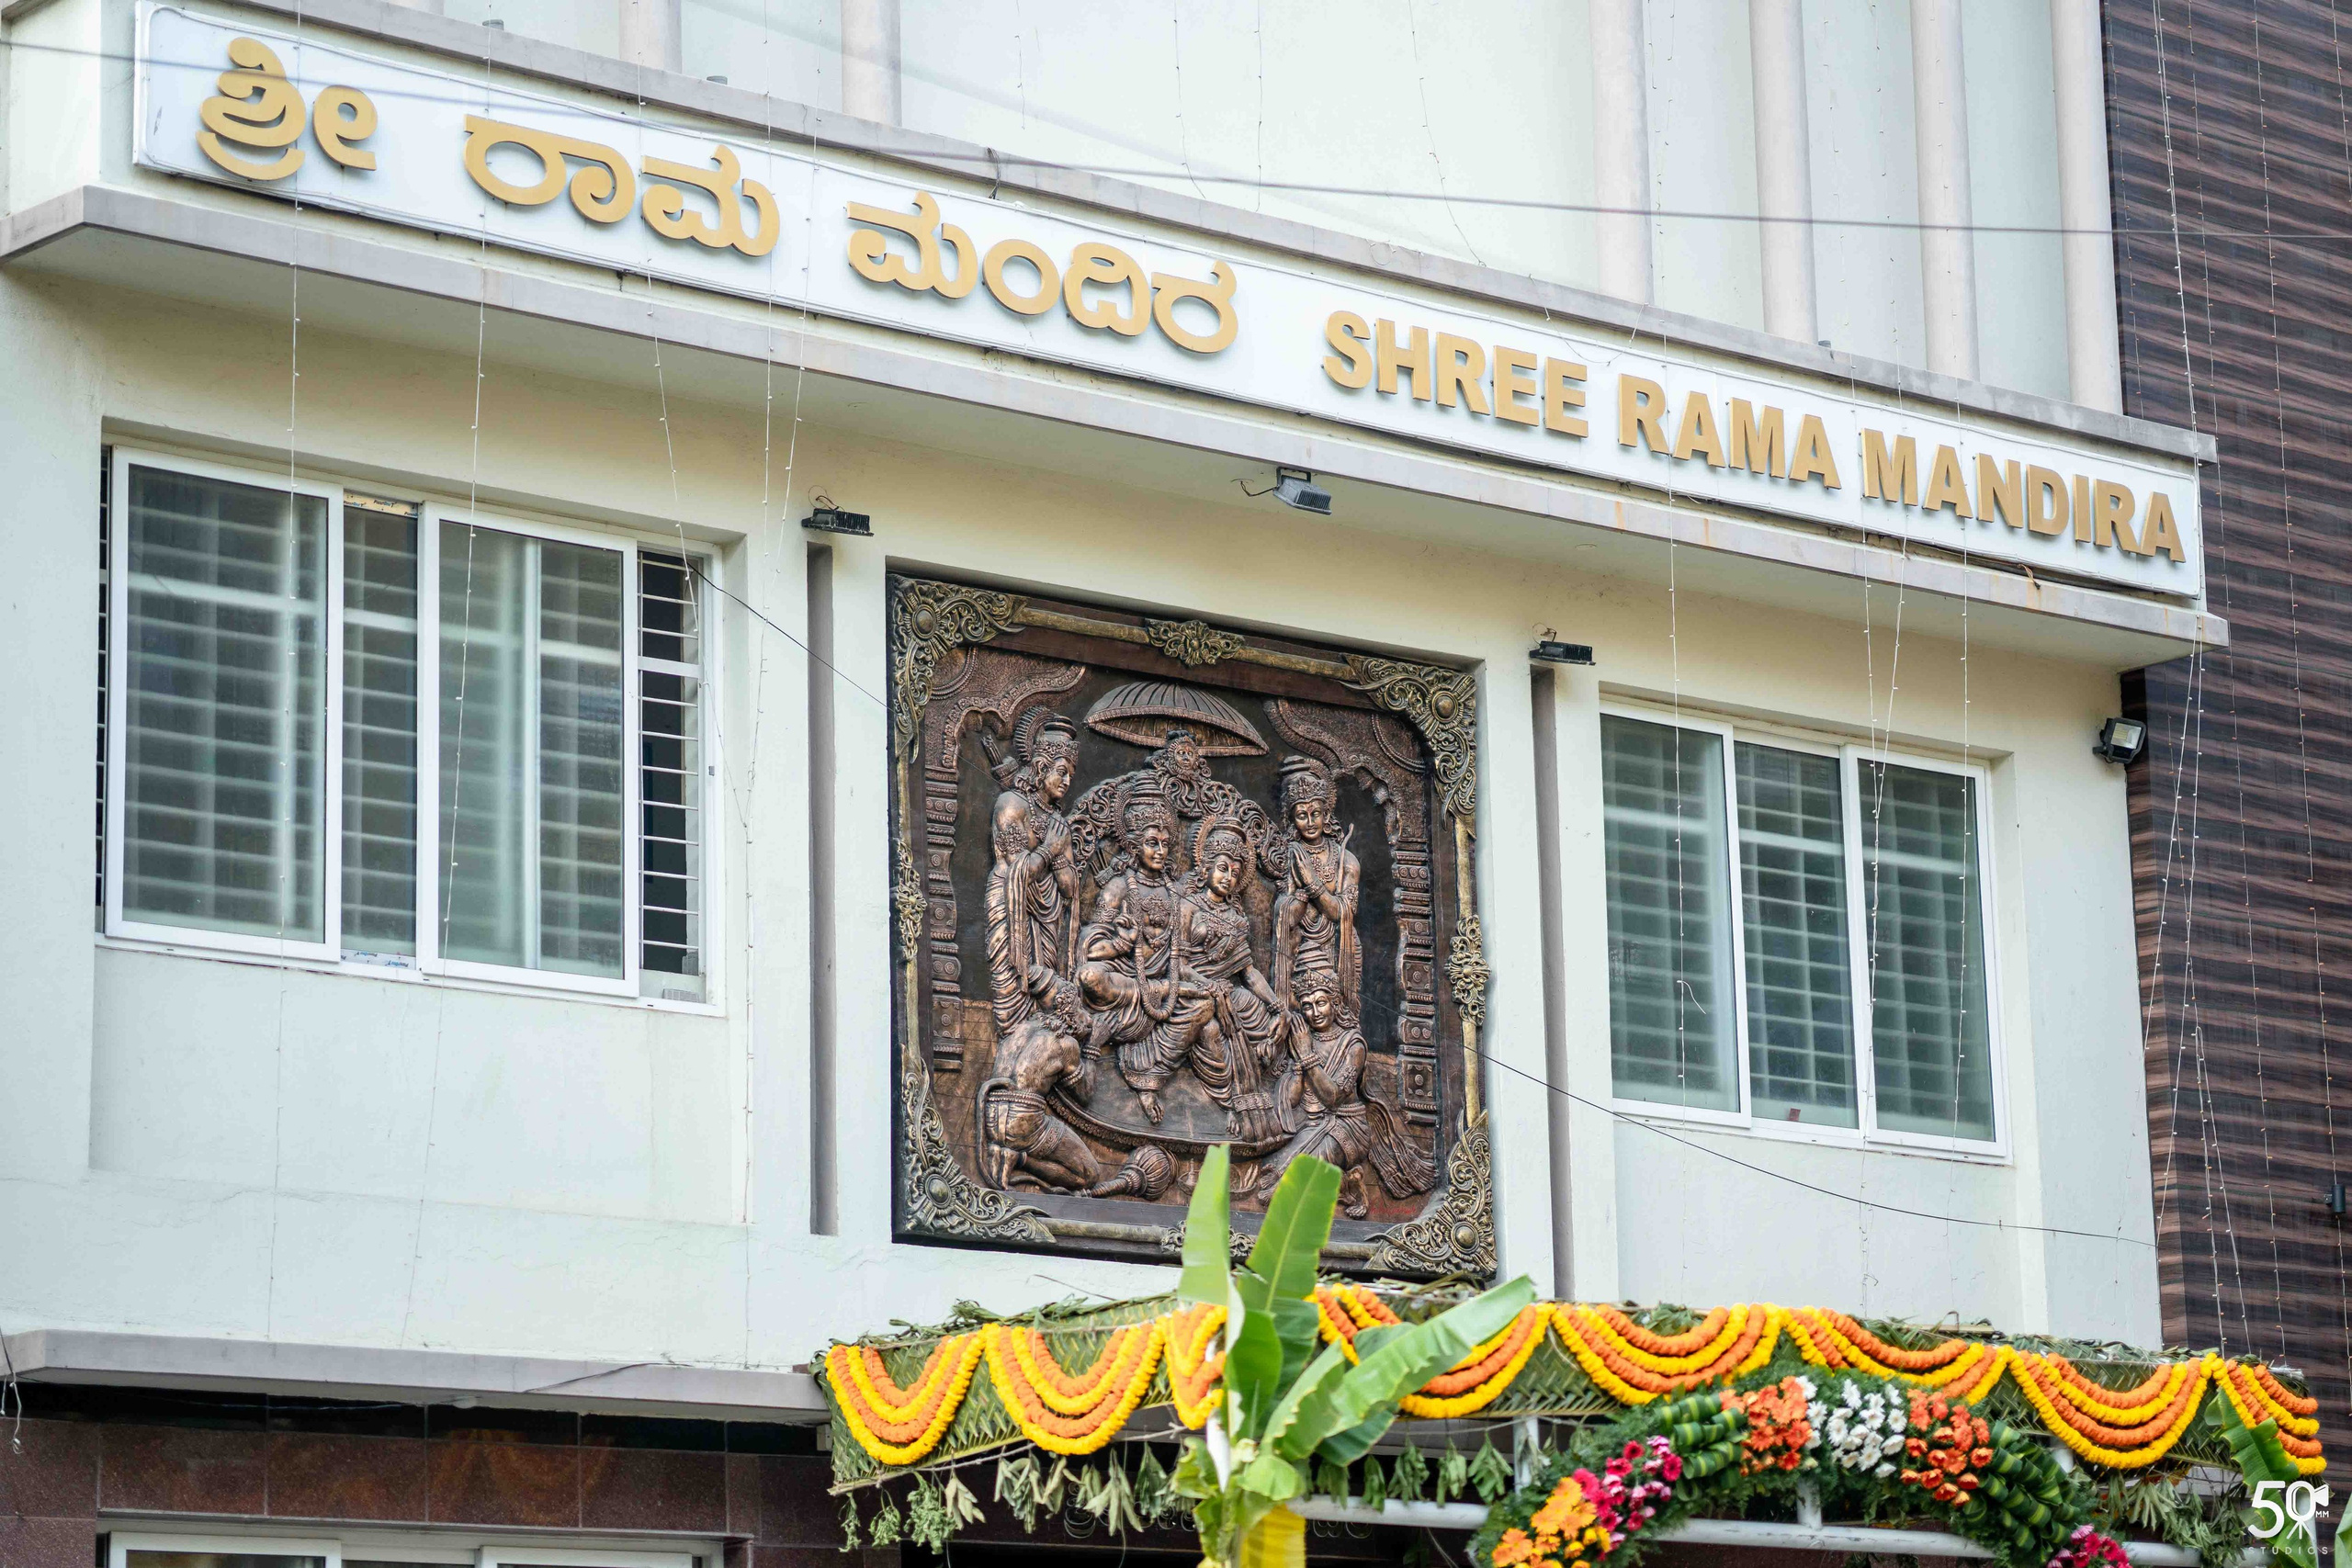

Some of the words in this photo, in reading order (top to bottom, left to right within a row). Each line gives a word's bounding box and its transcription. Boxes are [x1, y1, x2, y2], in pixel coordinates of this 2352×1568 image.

[197, 37, 378, 181] ಶ್ರೀ
[464, 114, 779, 257] ರಾಮ
[846, 189, 1238, 353] ಮಂದಿರ
[1323, 310, 1589, 437] SHREE
[1618, 372, 1841, 490] RAMA
[1860, 428, 2186, 563] MANDIRA
